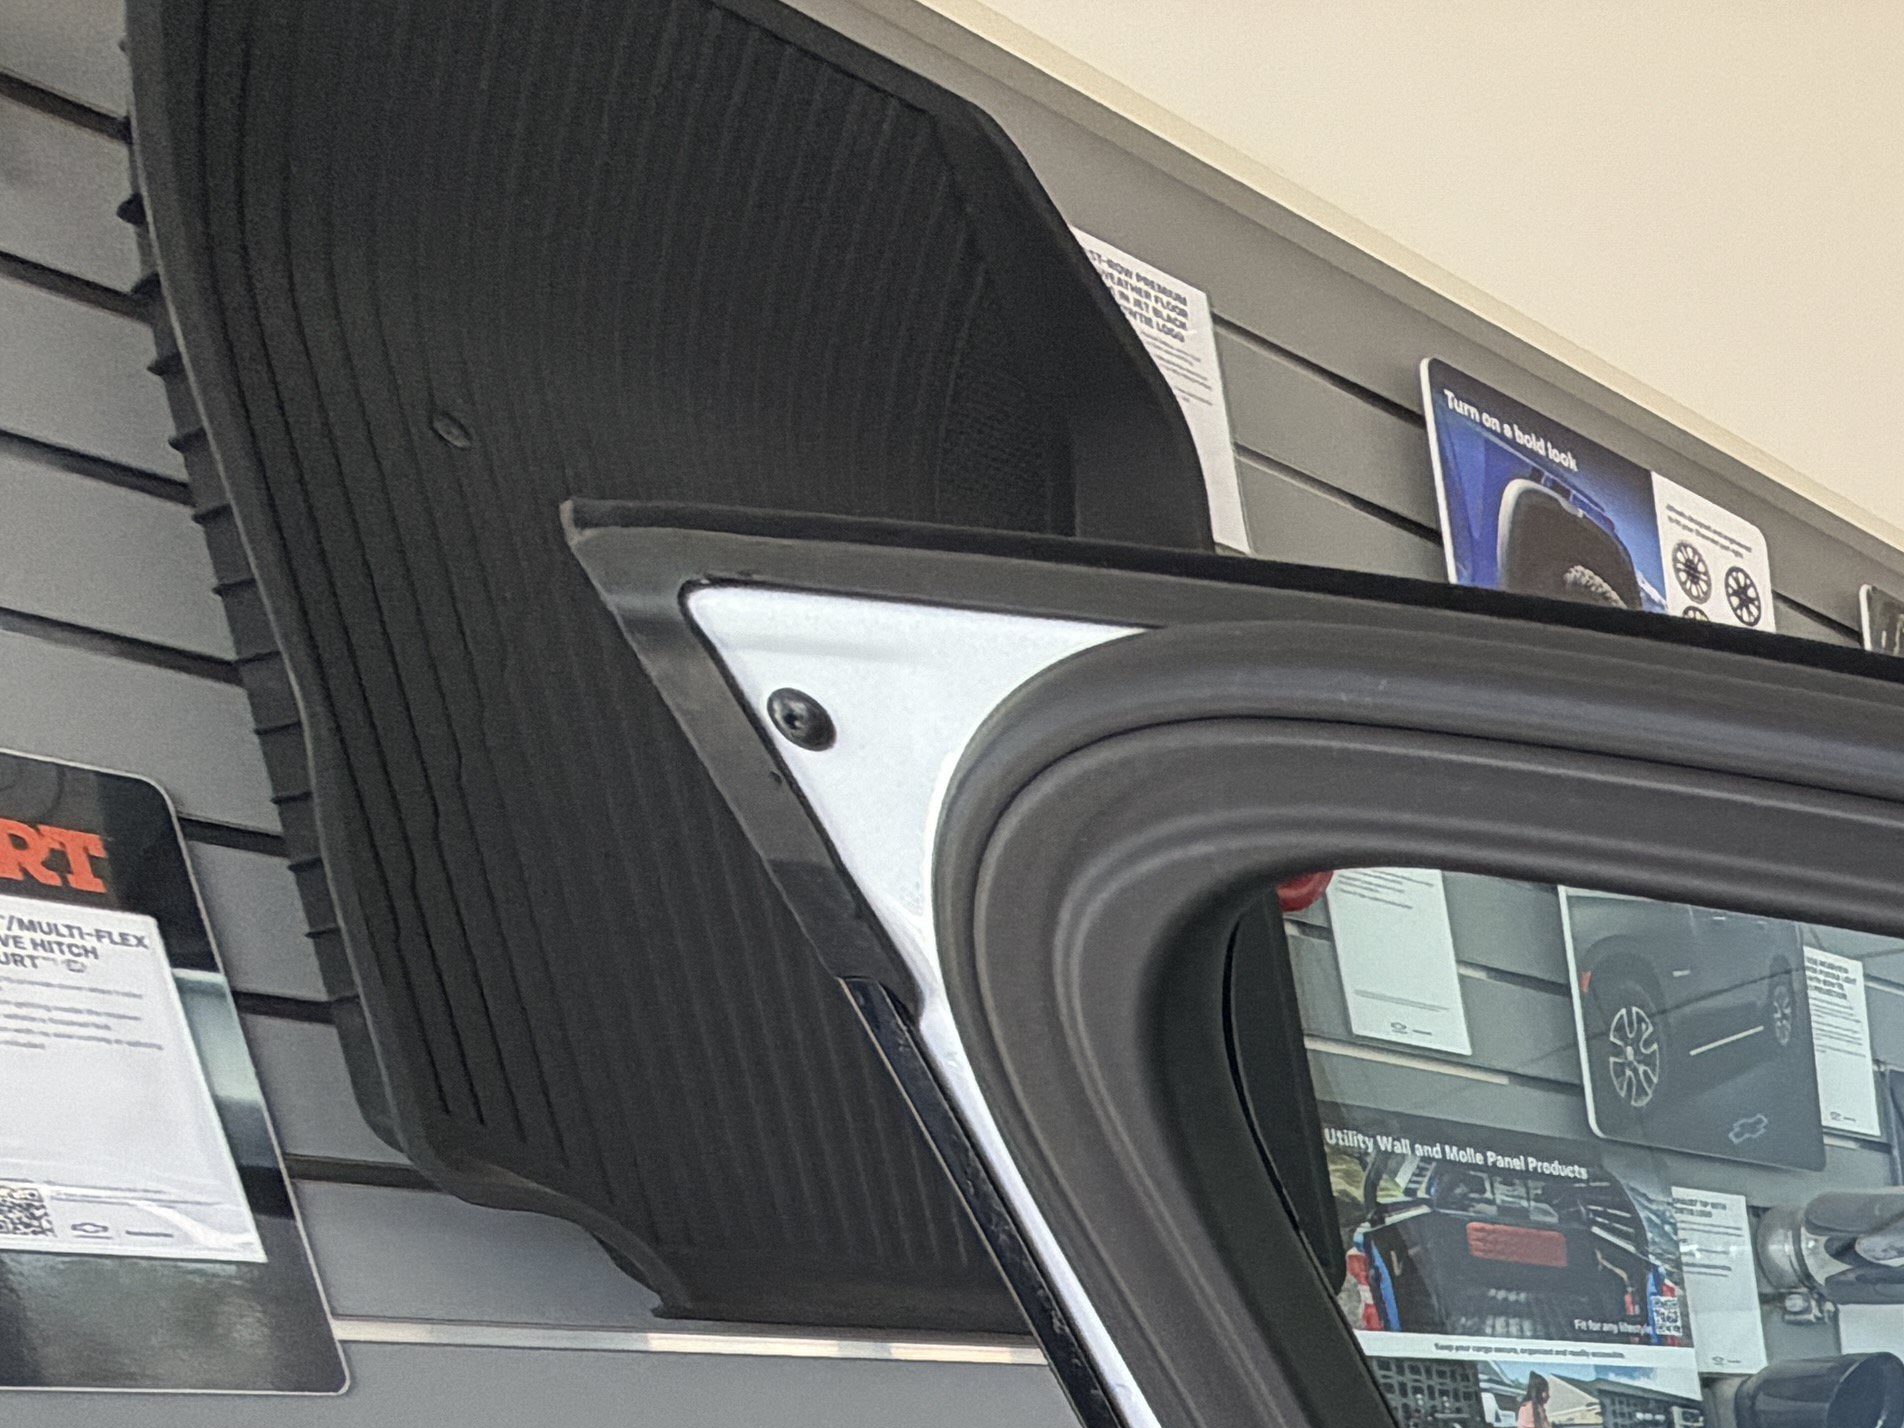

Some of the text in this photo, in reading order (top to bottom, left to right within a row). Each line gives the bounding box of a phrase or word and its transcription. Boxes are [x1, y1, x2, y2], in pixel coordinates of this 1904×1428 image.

[1444, 389, 1578, 471] Turn on a bold look
[0, 817, 108, 893] RT
[0, 915, 149, 949] /MULTI-FLEX
[30, 937, 99, 960] HITCH
[1324, 1128, 1588, 1180] Utility Wall and Molle Panel Products
